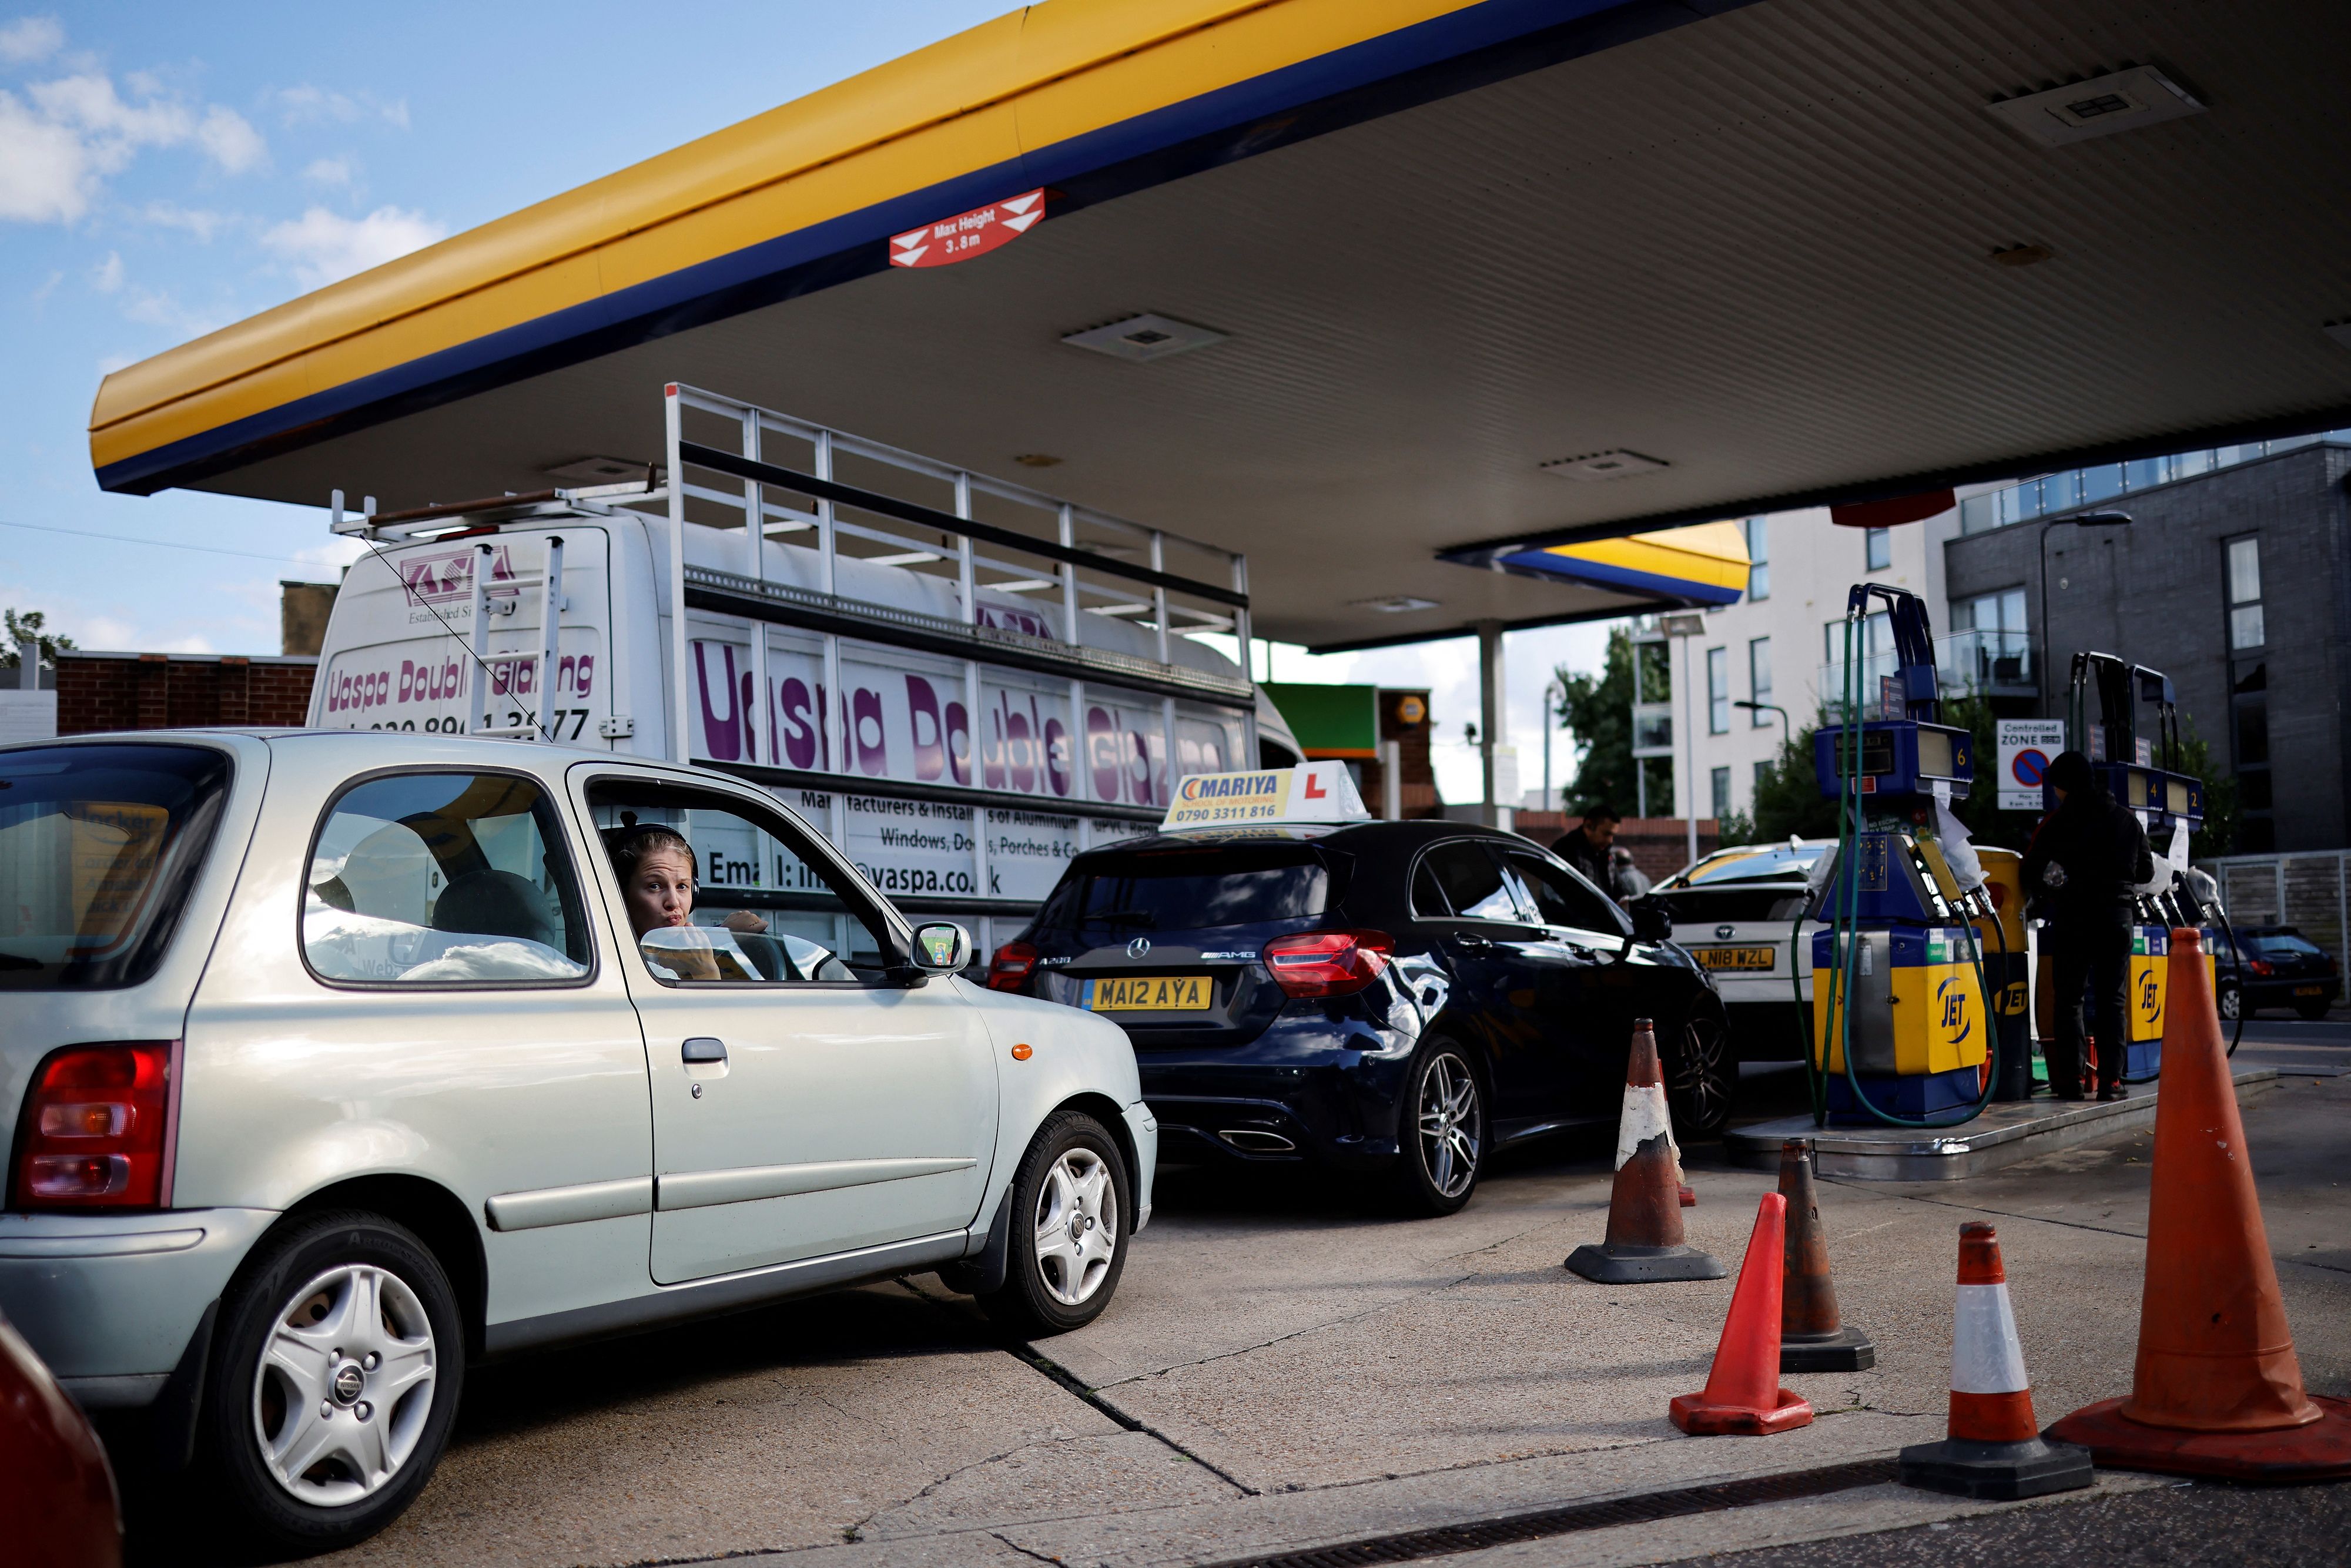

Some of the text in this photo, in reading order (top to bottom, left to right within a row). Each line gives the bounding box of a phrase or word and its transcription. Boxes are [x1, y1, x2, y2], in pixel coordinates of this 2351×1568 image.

[935, 209, 995, 239] Max Height
[409, 607, 458, 625] Established
[398, 654, 467, 704] Doubl
[2004, 723, 2057, 733] Controlled
[2001, 736, 2037, 745] ZONE
[1957, 748, 1965, 766] 6
[1199, 773, 1327, 799] MARIYA L
[2151, 783, 2157, 798] 4
[1182, 799, 1213, 808] SCHOOL
[1229, 795, 1275, 805] MOTORING
[2191, 793, 2198, 808] 2
[918, 803, 929, 817] &
[997, 809, 1009, 823] of
[1177, 805, 1275, 821] 0790 3311 816
[881, 827, 950, 852] Windows,
[1000, 836, 1049, 857] Porches
[1052, 841, 1061, 858] &
[709, 852, 792, 887] Emal:
[1738, 949, 1767, 965] WZL
[1156, 980, 1199, 1004] AYA
[2007, 988, 2027, 1007] JET
[2141, 983, 2158, 1009] JET
[1941, 994, 1965, 1028] JET
